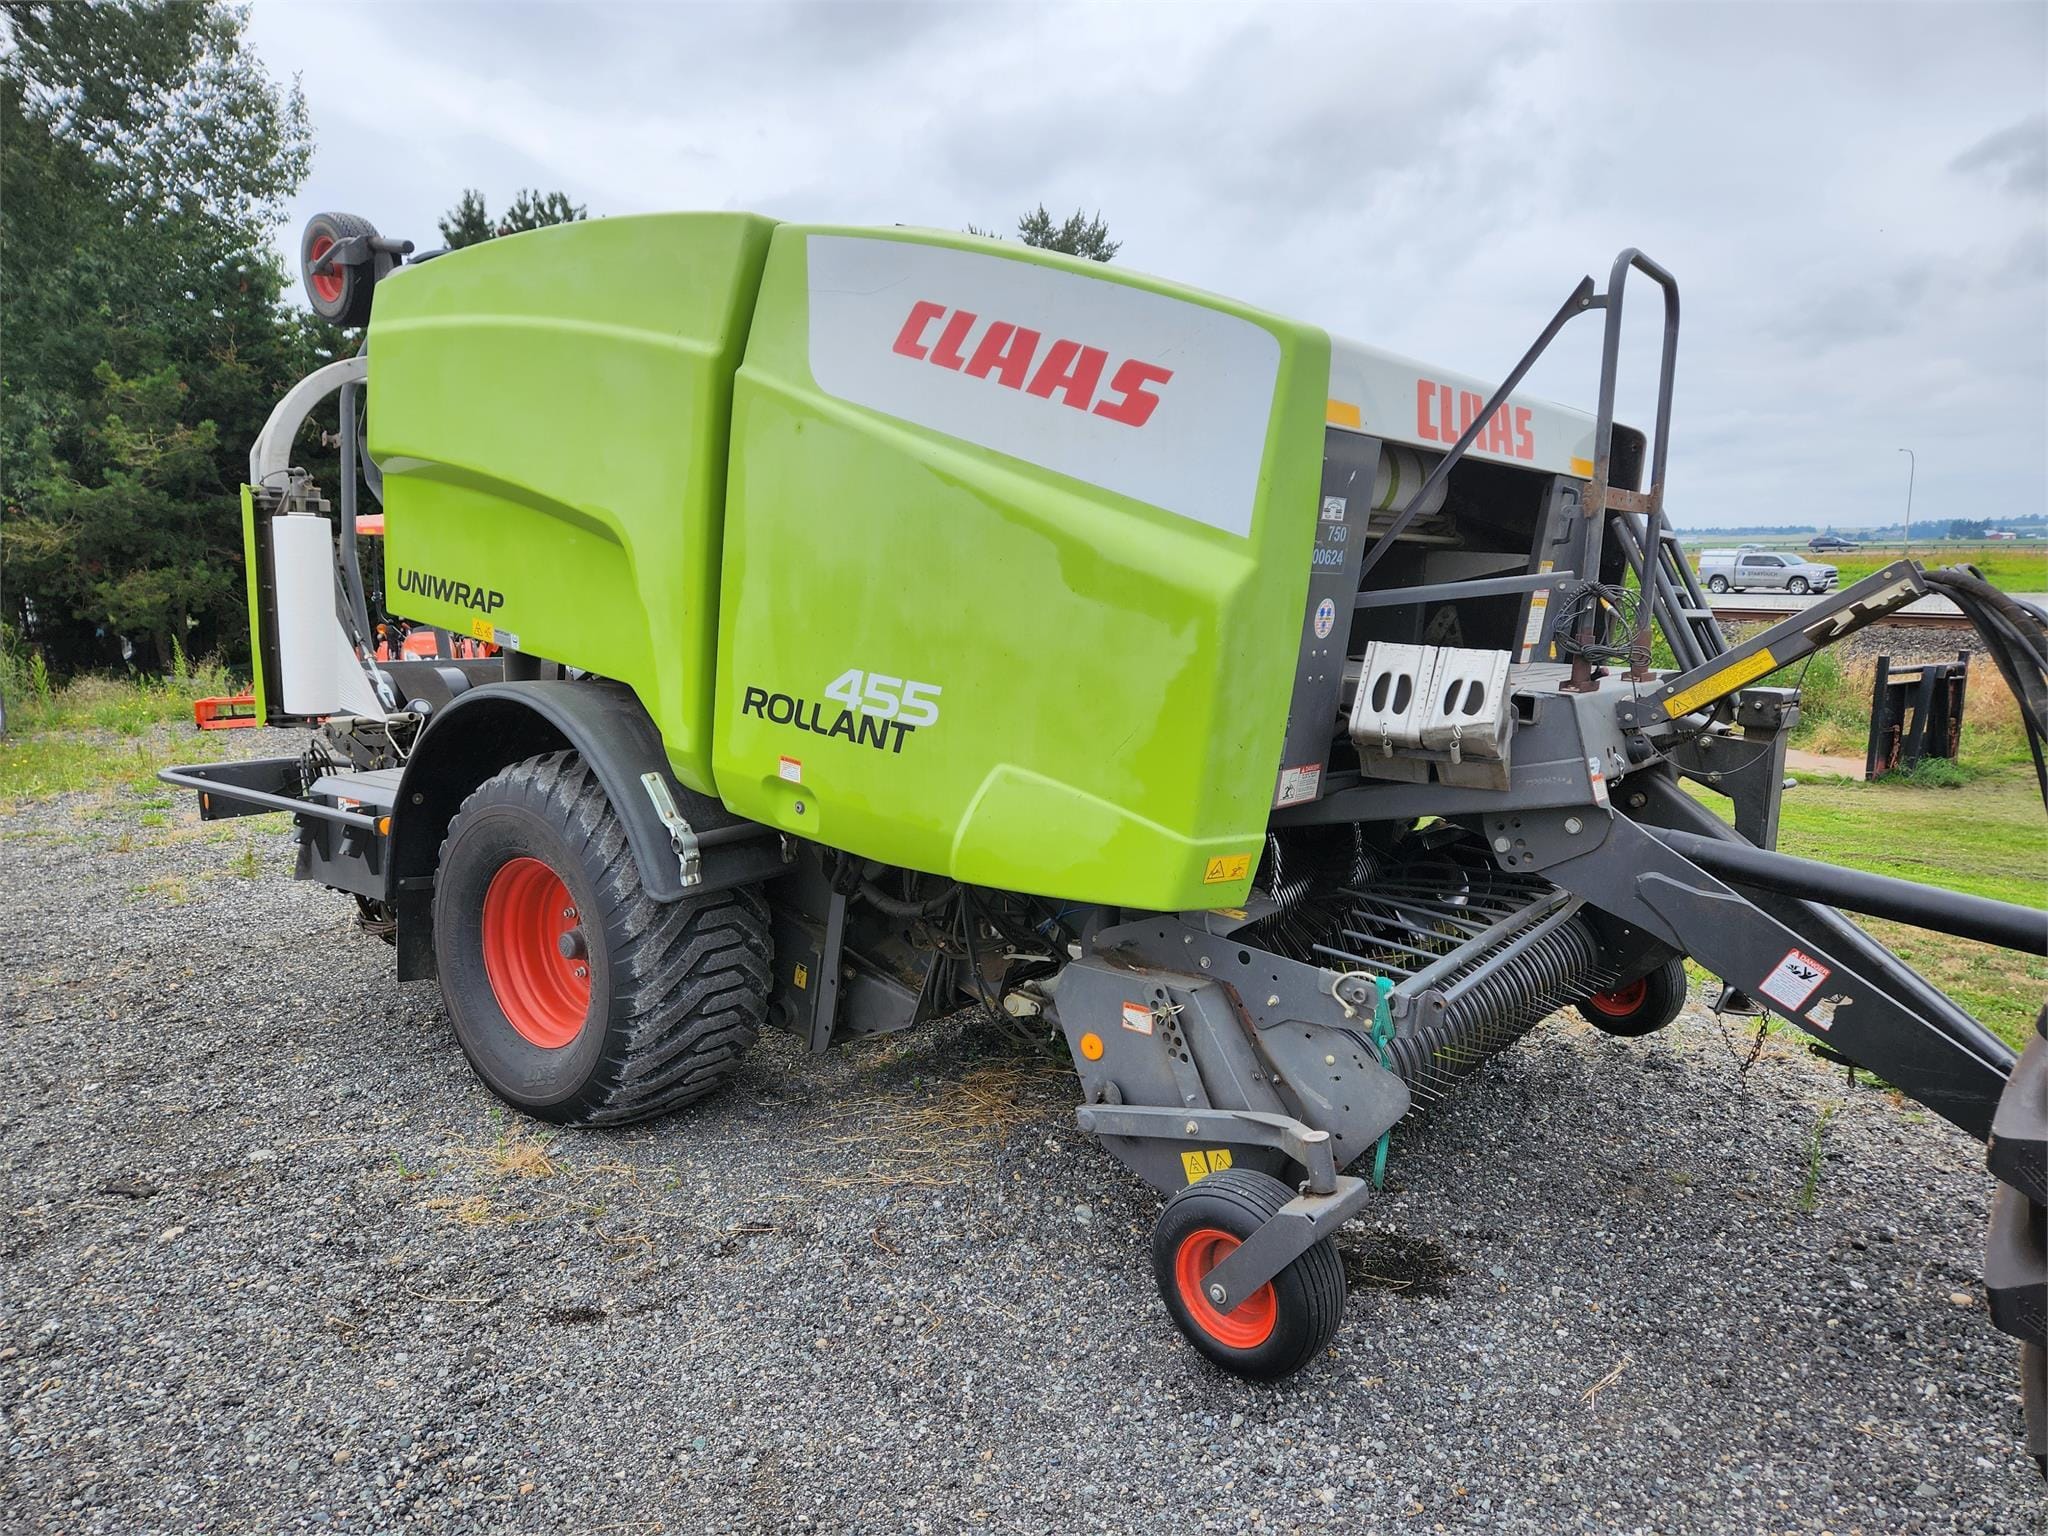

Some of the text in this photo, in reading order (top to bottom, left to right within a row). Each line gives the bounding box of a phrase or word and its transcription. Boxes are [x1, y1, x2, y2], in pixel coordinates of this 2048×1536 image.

[891, 300, 1174, 428] CLAAS
[1417, 379, 1534, 460] CLAAS
[1328, 526, 1346, 542] 750
[397, 567, 505, 614] UNIWRAP
[742, 686, 916, 754] ROLLANT
[824, 668, 943, 727] 455
[1799, 954, 1830, 976] DANGER
